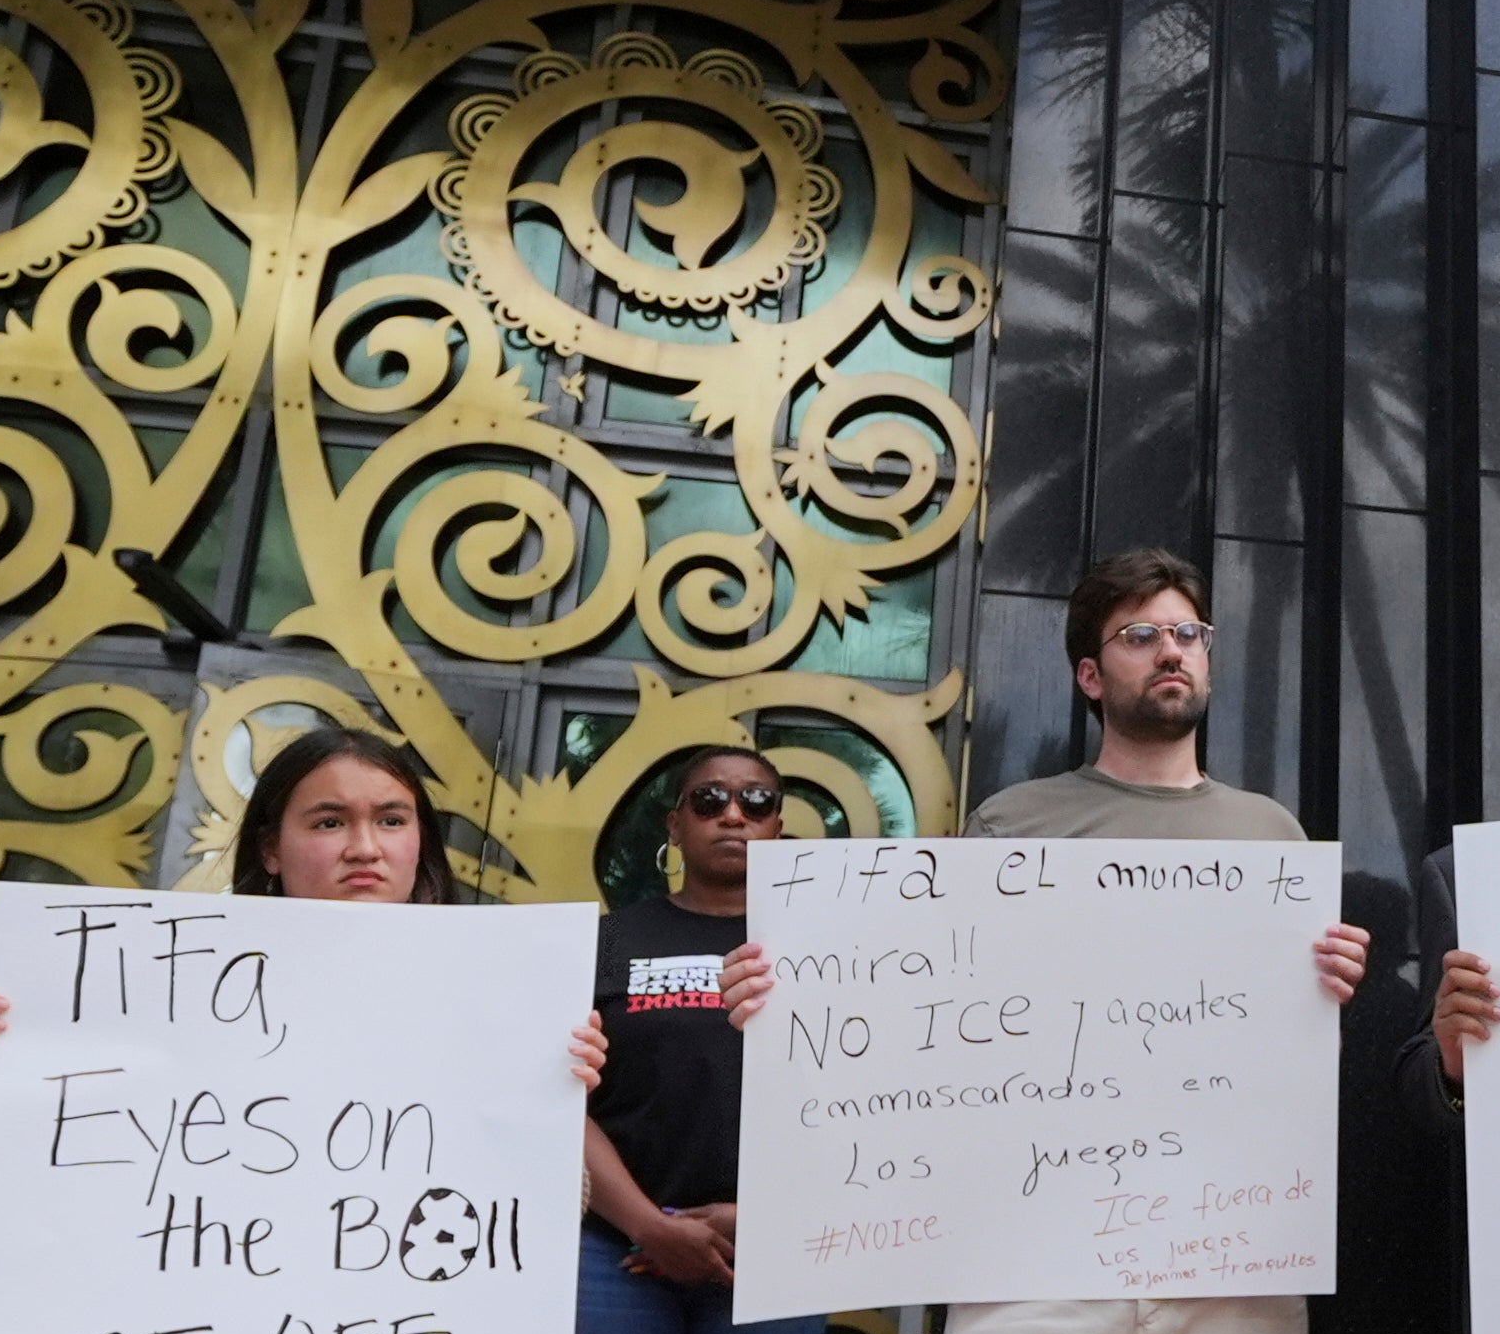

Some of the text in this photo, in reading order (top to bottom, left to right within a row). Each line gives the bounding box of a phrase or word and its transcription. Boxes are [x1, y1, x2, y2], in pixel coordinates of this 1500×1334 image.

[1097, 859, 1244, 892] mundo
[1267, 856, 1313, 905] te
[772, 924, 977, 985] mira!!
[789, 1006, 871, 1071] NO
[43, 1068, 435, 1206] Eyes on
[843, 1141, 933, 1190] Los
[1191, 1181, 1274, 1220] fuera
[1284, 1168, 1315, 1201] de
[138, 1193, 282, 1278] the
